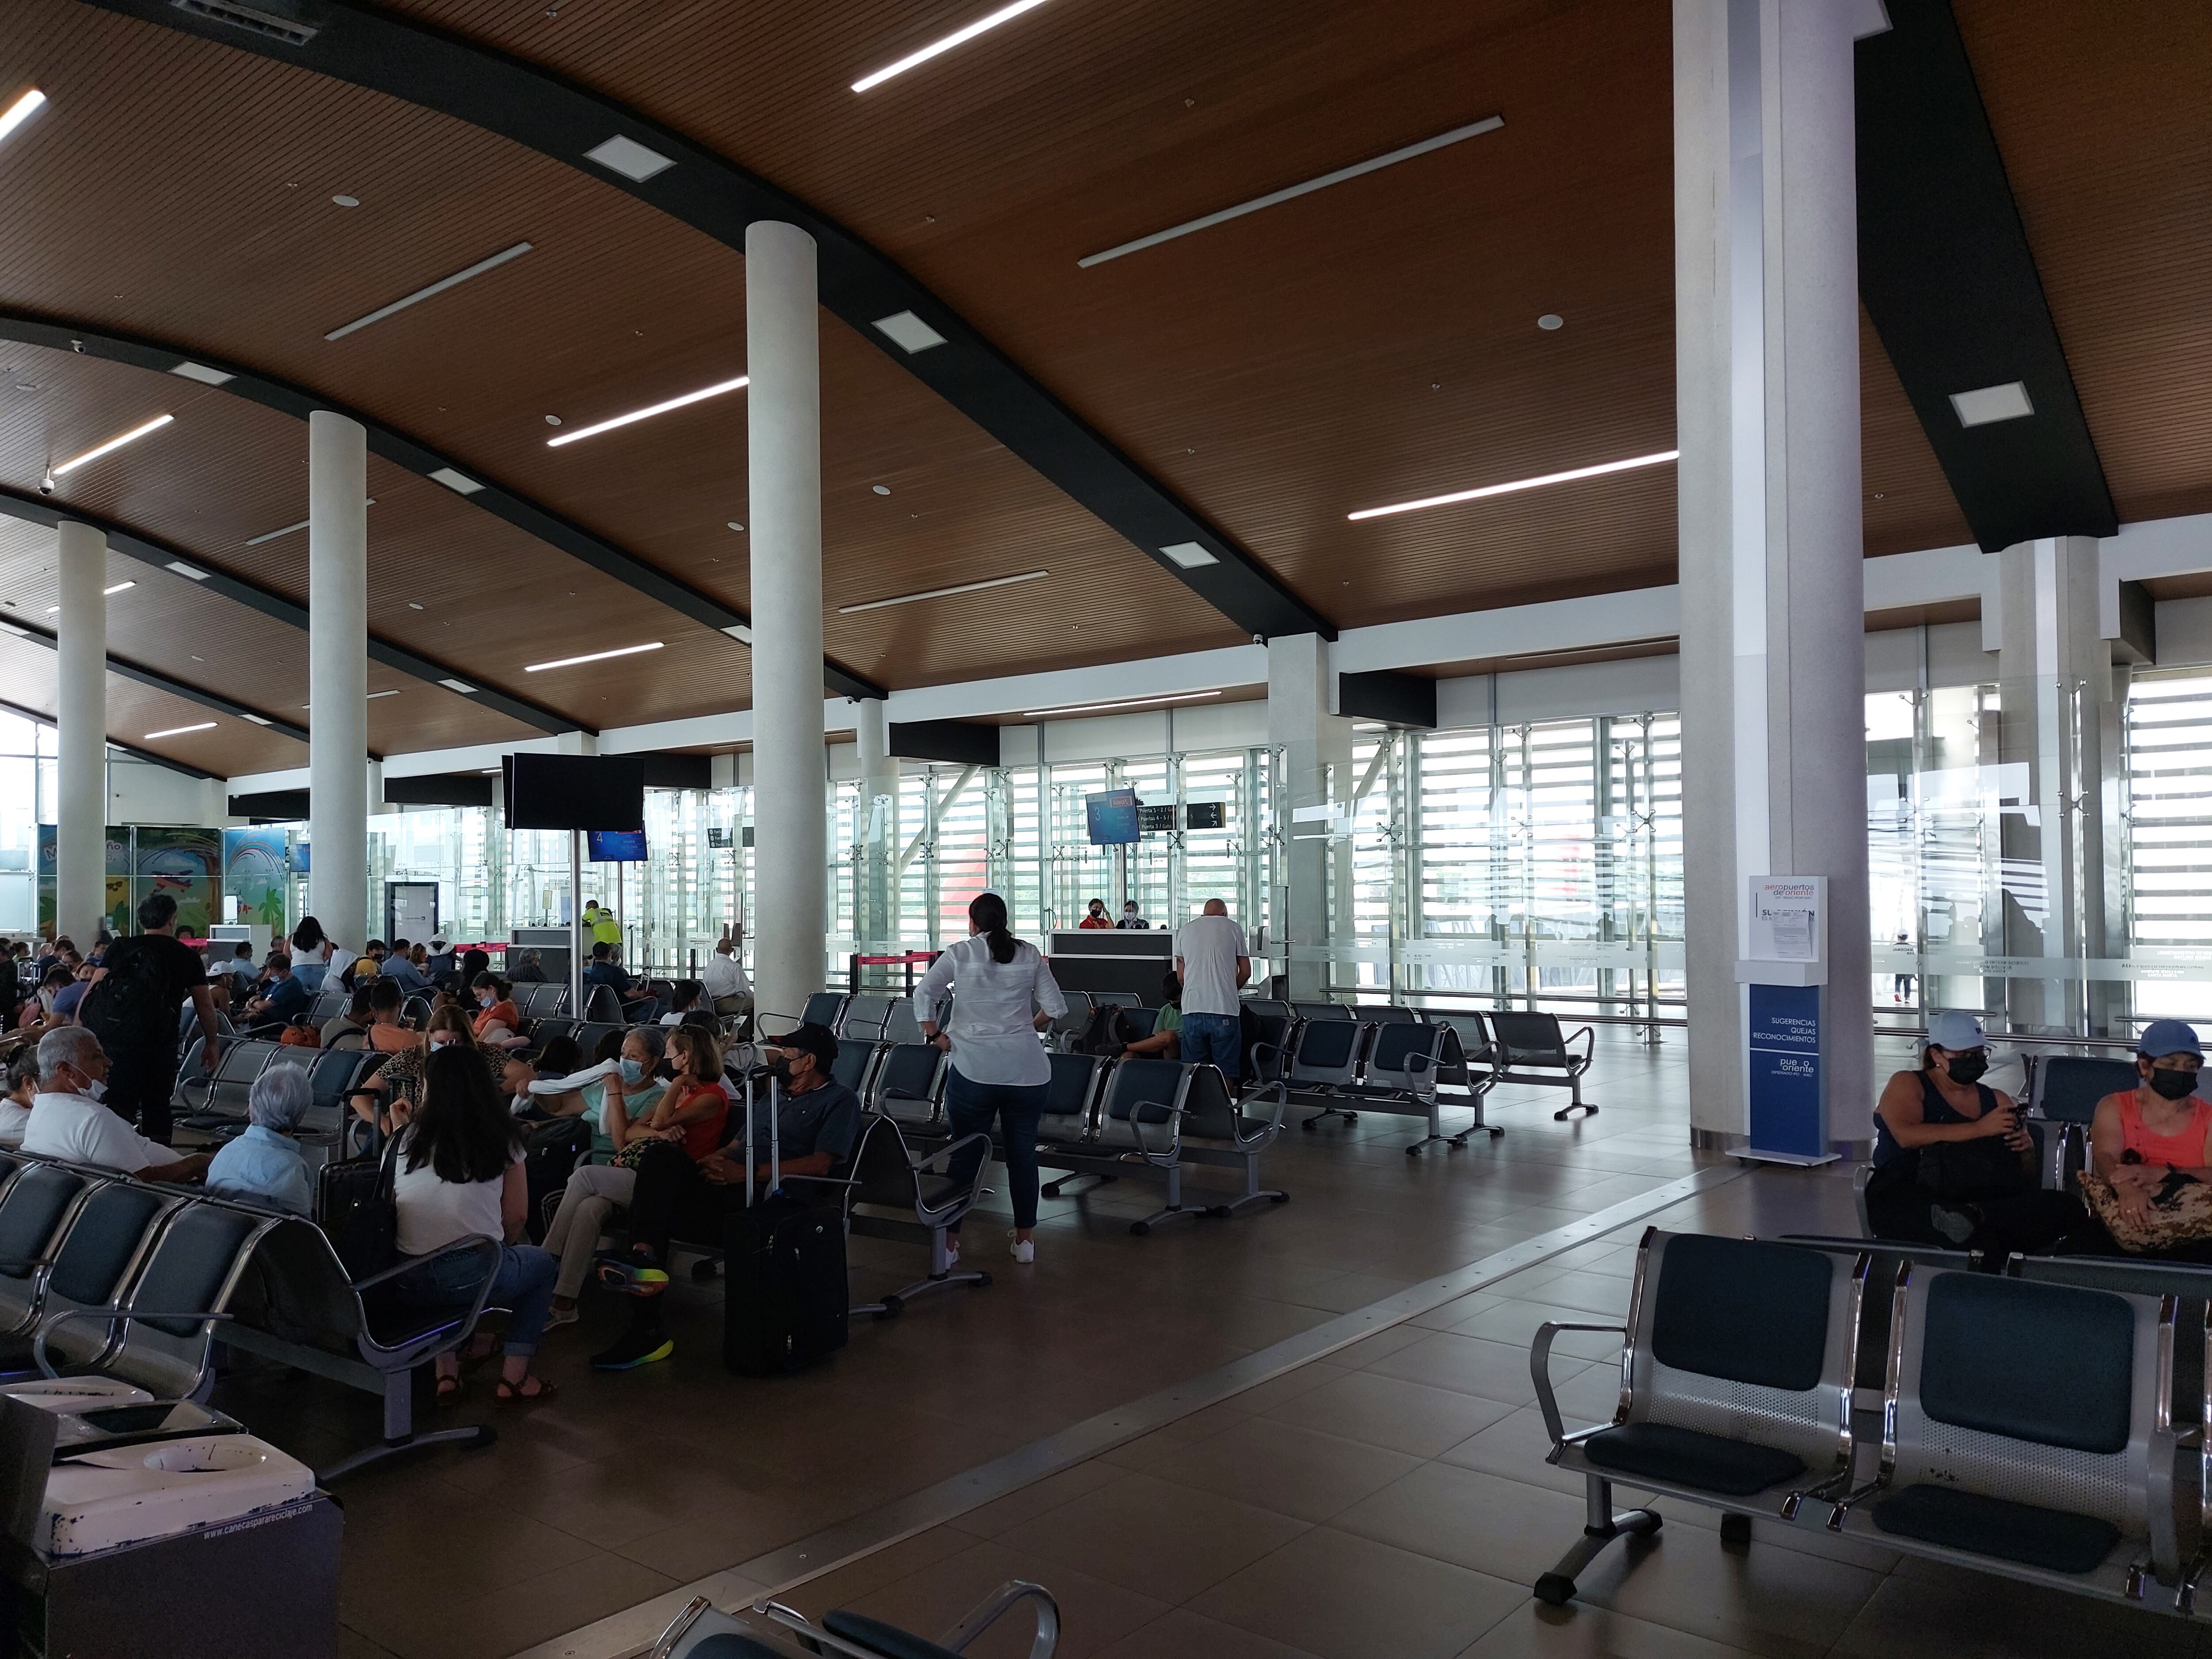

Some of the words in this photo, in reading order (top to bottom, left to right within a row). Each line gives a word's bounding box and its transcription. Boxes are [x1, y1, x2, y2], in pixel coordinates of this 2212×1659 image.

[1094, 807, 1101, 821] 3
[596, 832, 603, 843] 4
[1772, 1017, 1816, 1026] SUGERENCIAS
[1753, 1032, 1816, 1043] RECONOCIMIENTOS
[204, 1504, 313, 1540] www.canecasparareciclaje.com
